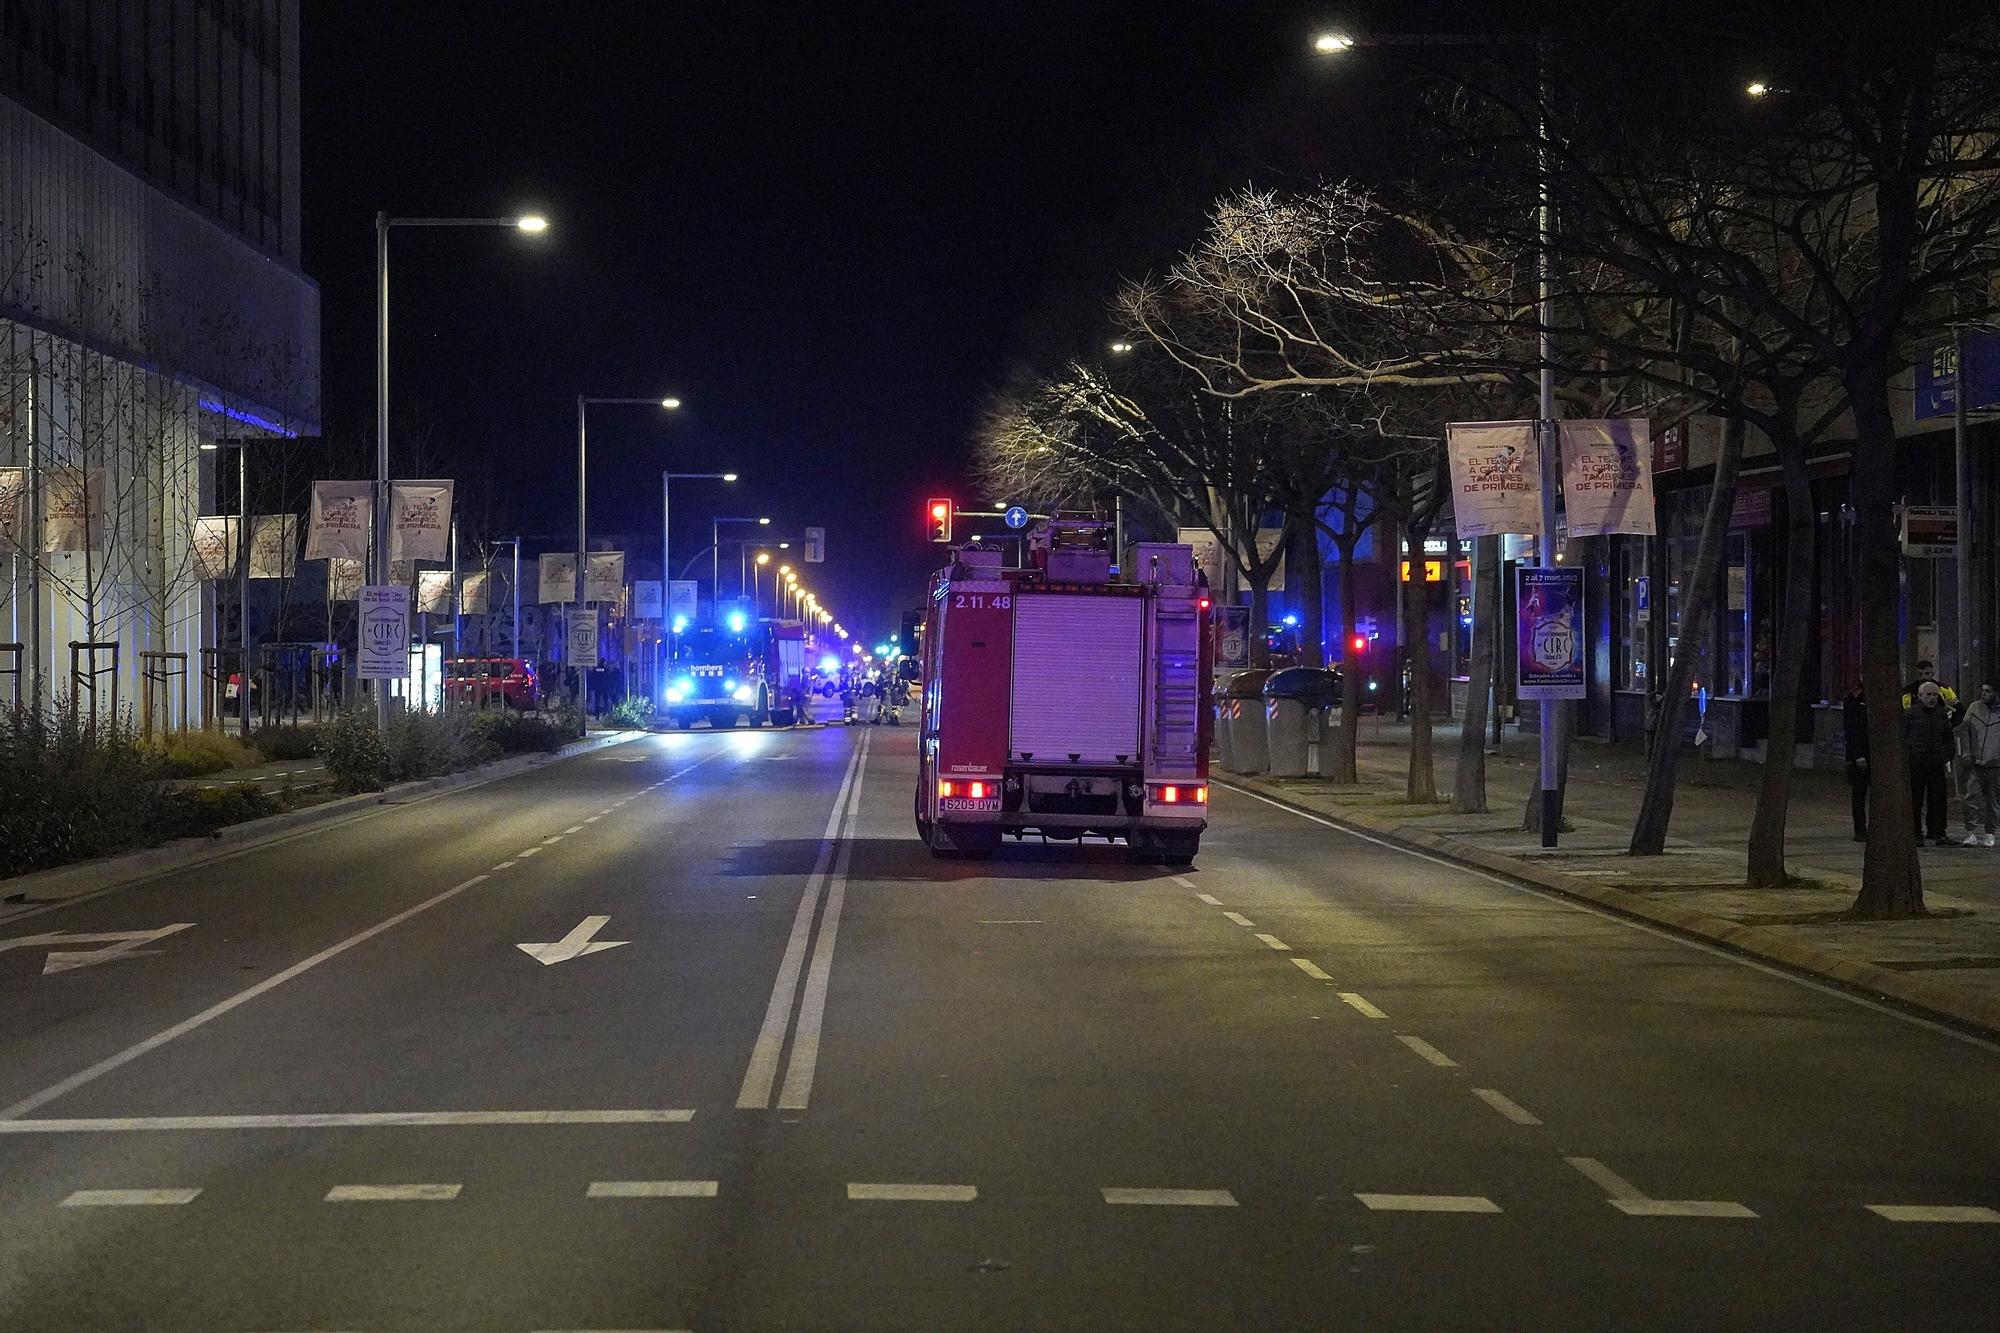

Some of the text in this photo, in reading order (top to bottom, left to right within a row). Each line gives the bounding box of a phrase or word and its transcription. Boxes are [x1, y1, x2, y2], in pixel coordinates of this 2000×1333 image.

[1469, 458, 1480, 466] EL
[1581, 455, 1594, 464] EL
[1464, 483, 1531, 492] DE PRIMERA
[1576, 482, 1643, 491] DE PRIMERA
[326, 522, 361, 530] PRIMERA
[406, 522, 442, 530] PRIMERA
[955, 595, 1011, 609] 2.11.48
[373, 623, 400, 640] CIRC
[1543, 637, 1569, 653] CIRC
[690, 664, 723, 672] bombers
[951, 761, 988, 772] rosenbauer
[947, 800, 999, 810] 6209 DVM
